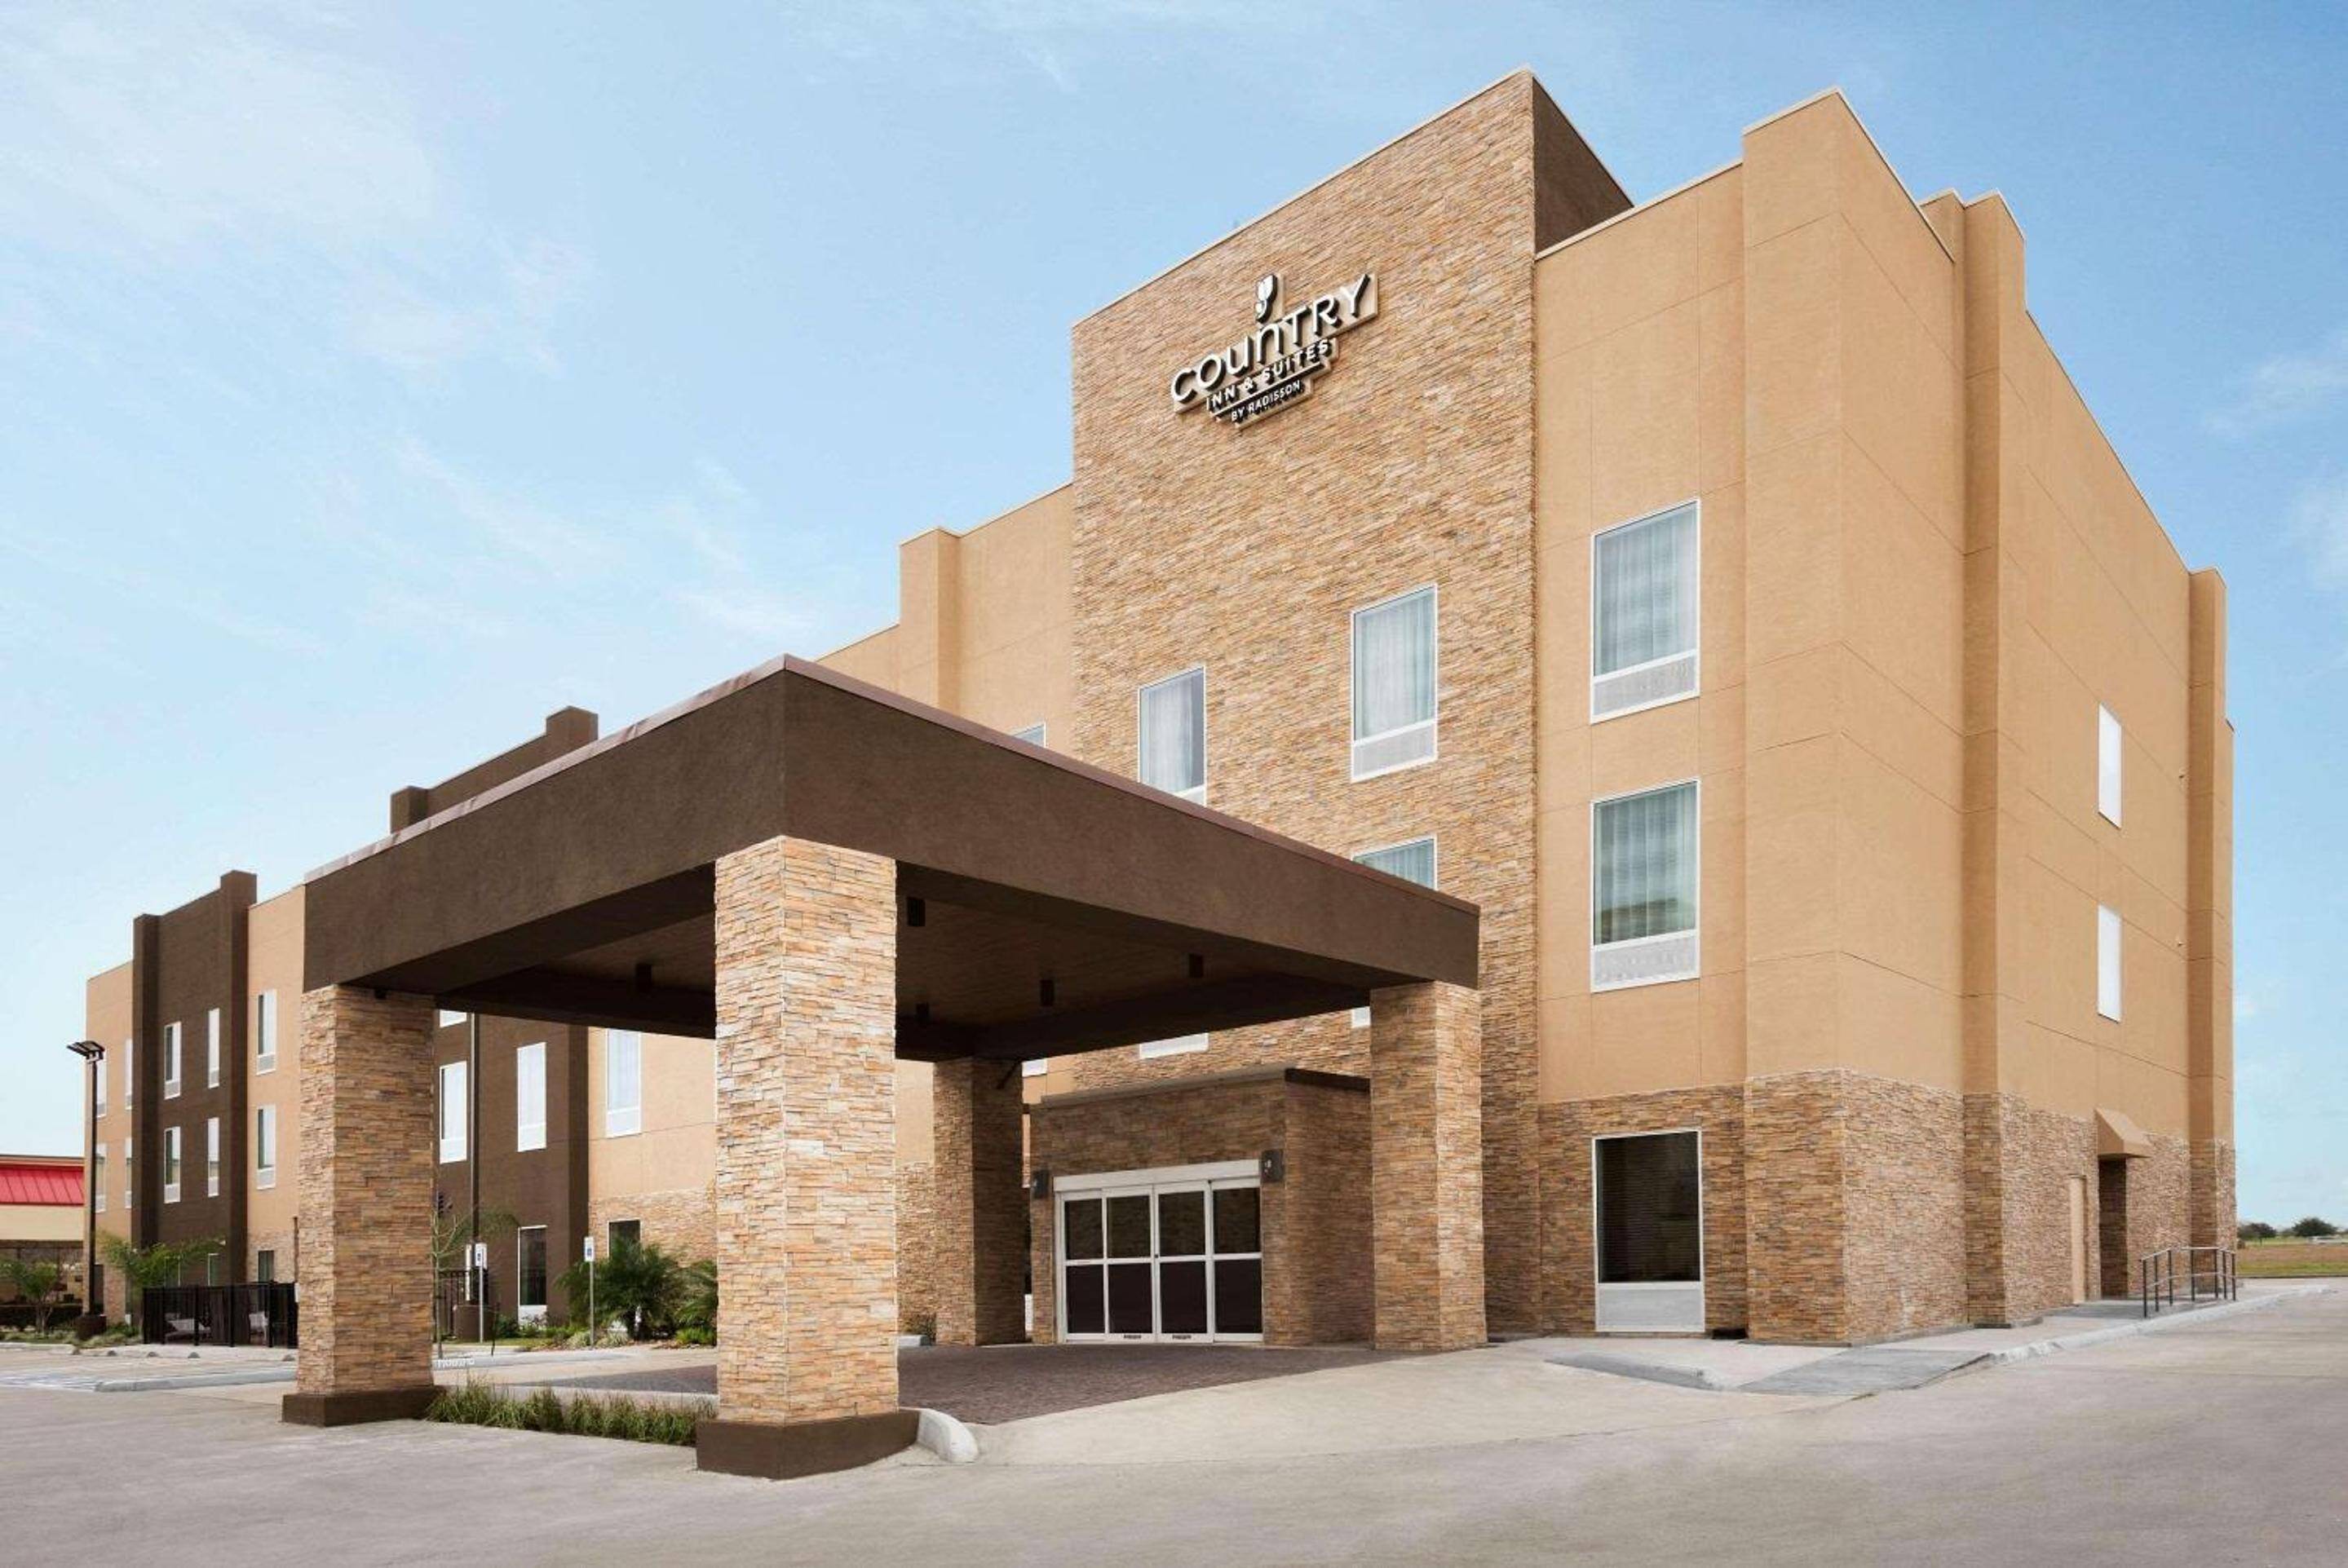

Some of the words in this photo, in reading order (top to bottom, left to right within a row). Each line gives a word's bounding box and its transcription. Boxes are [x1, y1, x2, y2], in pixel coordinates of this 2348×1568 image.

[1206, 384, 1236, 411] INN
[1244, 377, 1254, 391] &
[1262, 338, 1329, 380] SUITES
[1231, 407, 1245, 422] BY
[1248, 379, 1301, 413] RADISSON
